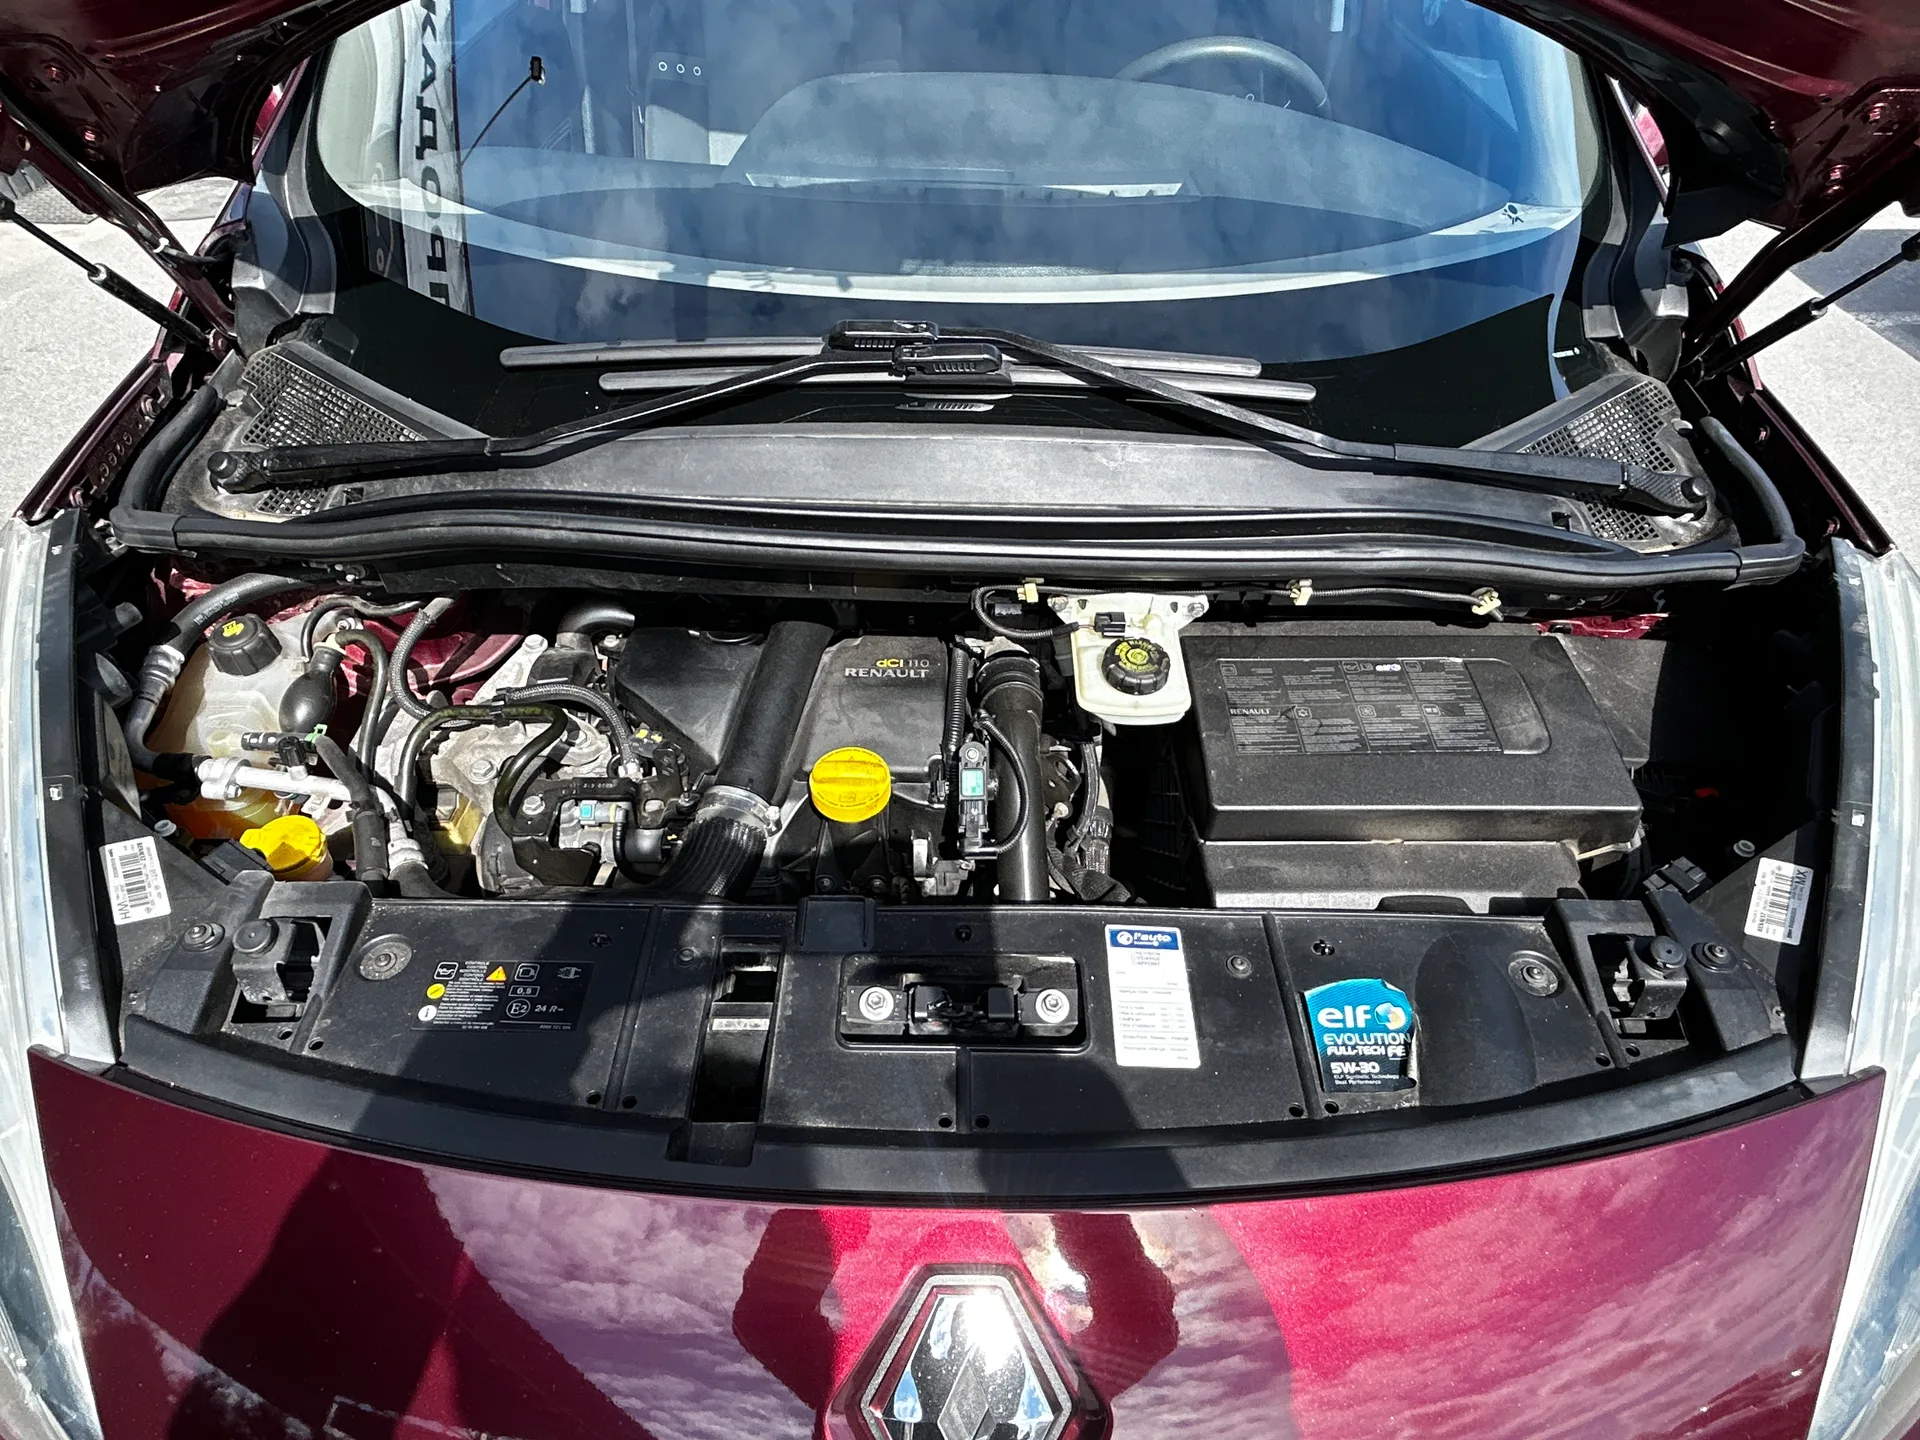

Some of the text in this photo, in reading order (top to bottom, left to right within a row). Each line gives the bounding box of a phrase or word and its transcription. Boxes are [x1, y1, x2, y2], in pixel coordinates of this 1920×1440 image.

[908, 659, 930, 668] 110
[844, 667, 930, 678] RENAULT
[1229, 708, 1271, 716] RENAULT
[1795, 869, 1808, 886] MX
[117, 900, 131, 920] WH
[510, 1003, 528, 1015] E2
[534, 1004, 547, 1012] 24
[1317, 1004, 1372, 1029] elf
[1323, 1032, 1412, 1046] EVOLUTION
[1327, 1045, 1406, 1057] FULL-TECH FE
[1330, 1061, 1380, 1074] 5W-30
